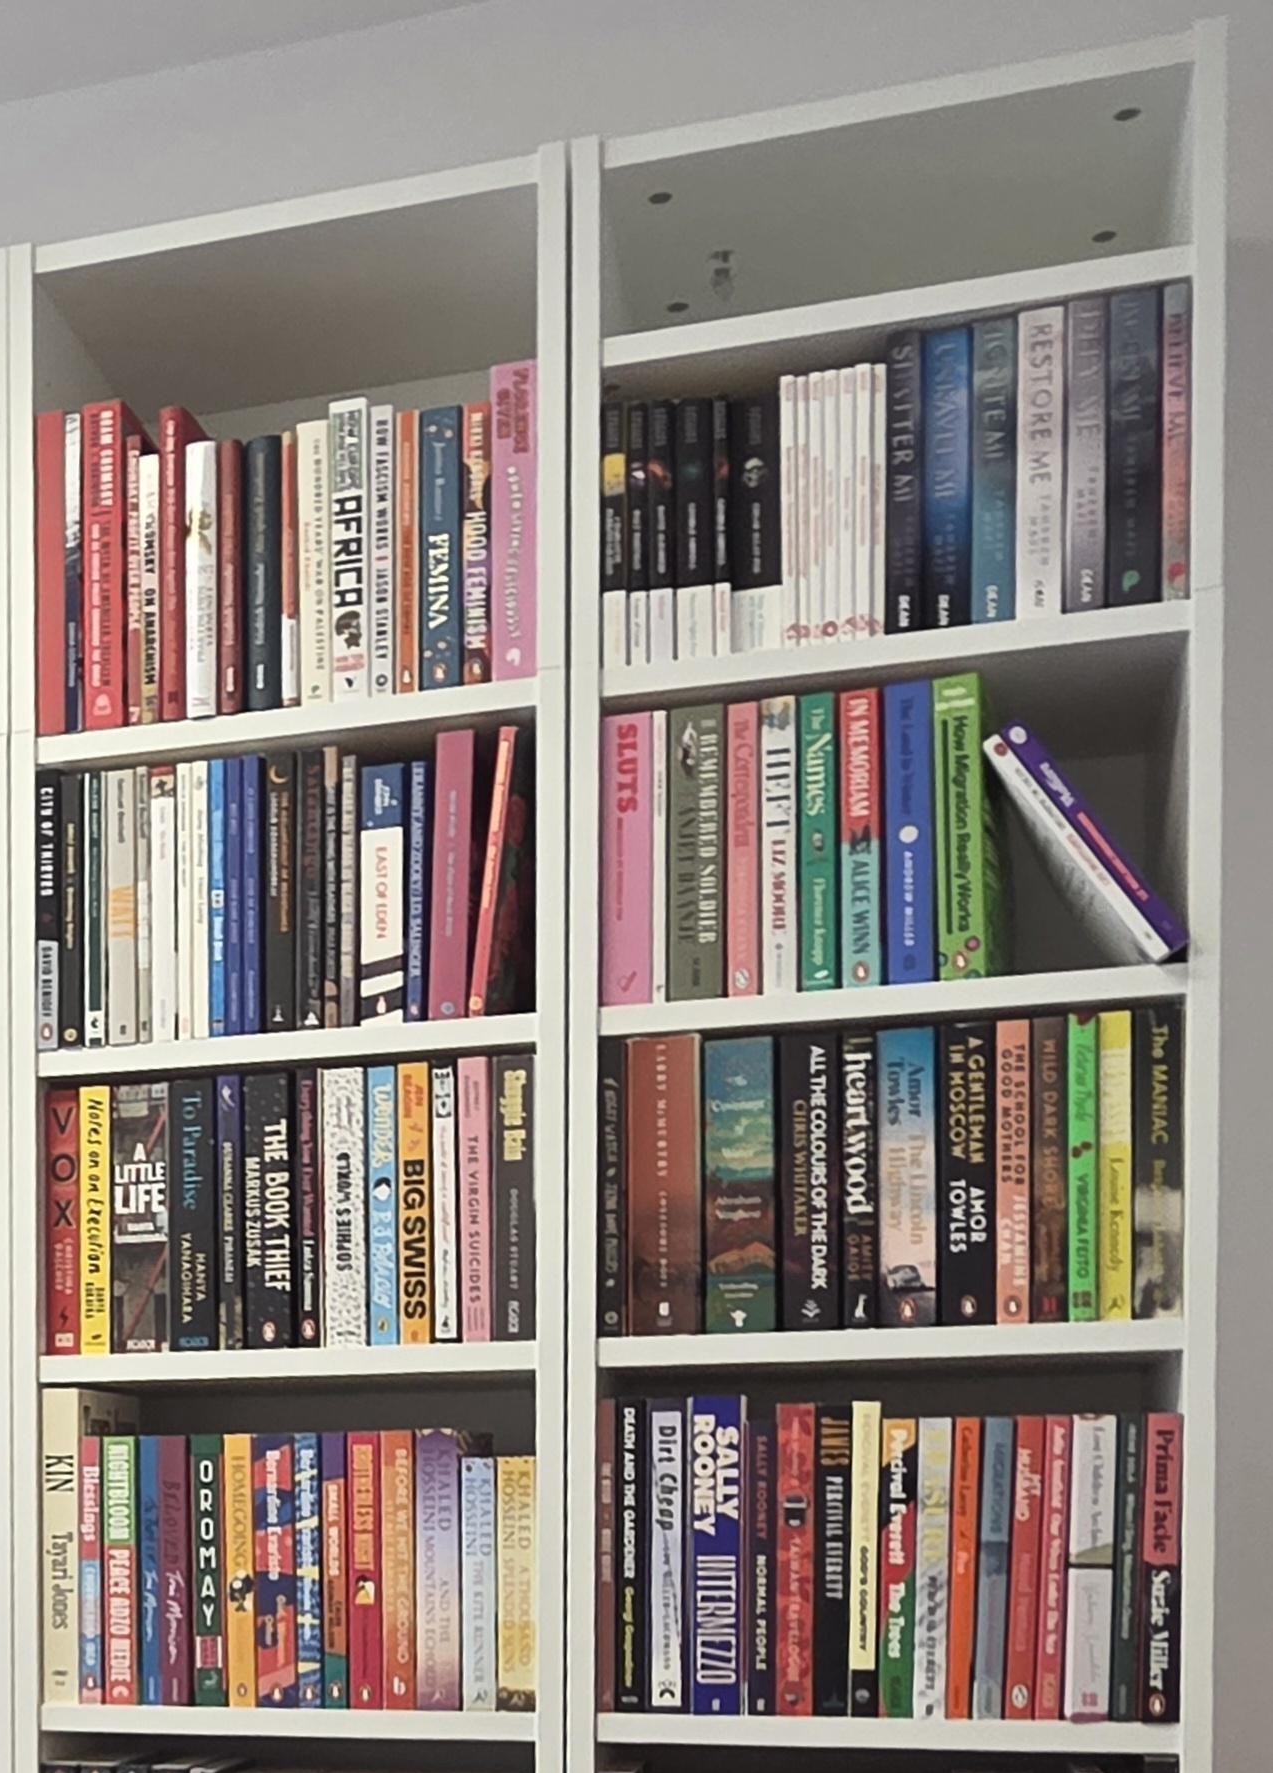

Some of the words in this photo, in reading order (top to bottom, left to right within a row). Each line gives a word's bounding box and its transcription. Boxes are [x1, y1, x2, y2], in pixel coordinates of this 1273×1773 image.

[1030, 323, 1053, 446] RESTORE
[376, 452, 388, 503] FASCISM
[1031, 451, 1053, 485] ME
[333, 495, 362, 608] AFRICA
[467, 512, 487, 562] HOOD
[428, 533, 449, 630] FEMINA
[465, 567, 487, 650] FEMINISM
[376, 607, 388, 660] STANLEY
[617, 723, 638, 814] SLUTS
[848, 719, 869, 817] MEMORIAM
[40, 787, 55, 816] CITY
[40, 843, 54, 897] THIEVES
[375, 845, 388, 878] EAST
[851, 860, 870, 908] ALICE
[375, 903, 389, 939] EDEN
[852, 909, 870, 955] WINN
[810, 1045, 826, 1072] ALL
[949, 1045, 966, 1063] IN
[181, 1093, 202, 1119] To
[810, 1074, 826, 1108] THE
[949, 1068, 966, 1158] MOSCOW
[968, 1053, 986, 1163] GENTLEMAN
[1151, 1064, 1167, 1144] MANIAC
[87, 1097, 104, 1144] Notes
[264, 1118, 288, 1163] THE
[810, 1110, 826, 1184] COLOURS
[845, 1051, 873, 1214] heartwood
[114, 1162, 166, 1184] LITTLE
[133, 1142, 146, 1161] A
[181, 1125, 203, 1210] Paradise
[113, 1182, 167, 1215] LIFE
[245, 1156, 261, 1217] MARKUS
[264, 1171, 290, 1229] BOOK
[403, 1158, 424, 1211] BIG
[810, 1187, 826, 1209] OF
[86, 1197, 104, 1274] Execution
[810, 1211, 826, 1241] THE
[949, 1178, 966, 1252] TOWLES
[969, 1184, 986, 1240] AMOR
[245, 1220, 261, 1266] ZUSAK
[263, 1233, 291, 1291] THIEF
[403, 1216, 426, 1319] SWISS
[810, 1242, 826, 1290] DARK
[179, 1232, 192, 1323] YANAGIHARA
[193, 1252, 206, 1301] HANYA
[624, 1408, 636, 1448] DEATH
[658, 1425, 676, 1462] Dirt
[45, 1454, 73, 1493] KIN
[624, 1453, 636, 1481] AND
[692, 1415, 716, 1535] ROONEY
[715, 1427, 739, 1519] SALLY
[1154, 1429, 1175, 1494] Prima
[82, 1465, 99, 1543] Blessings
[230, 1455, 247, 1568] HOMEGOING
[656, 1472, 678, 1531] Cheap
[1152, 1499, 1173, 1553] Facie
[199, 1459, 217, 1627] OROMAY
[624, 1509, 636, 1580] GARDENER
[696, 1555, 737, 1686] INTERMEZZO
